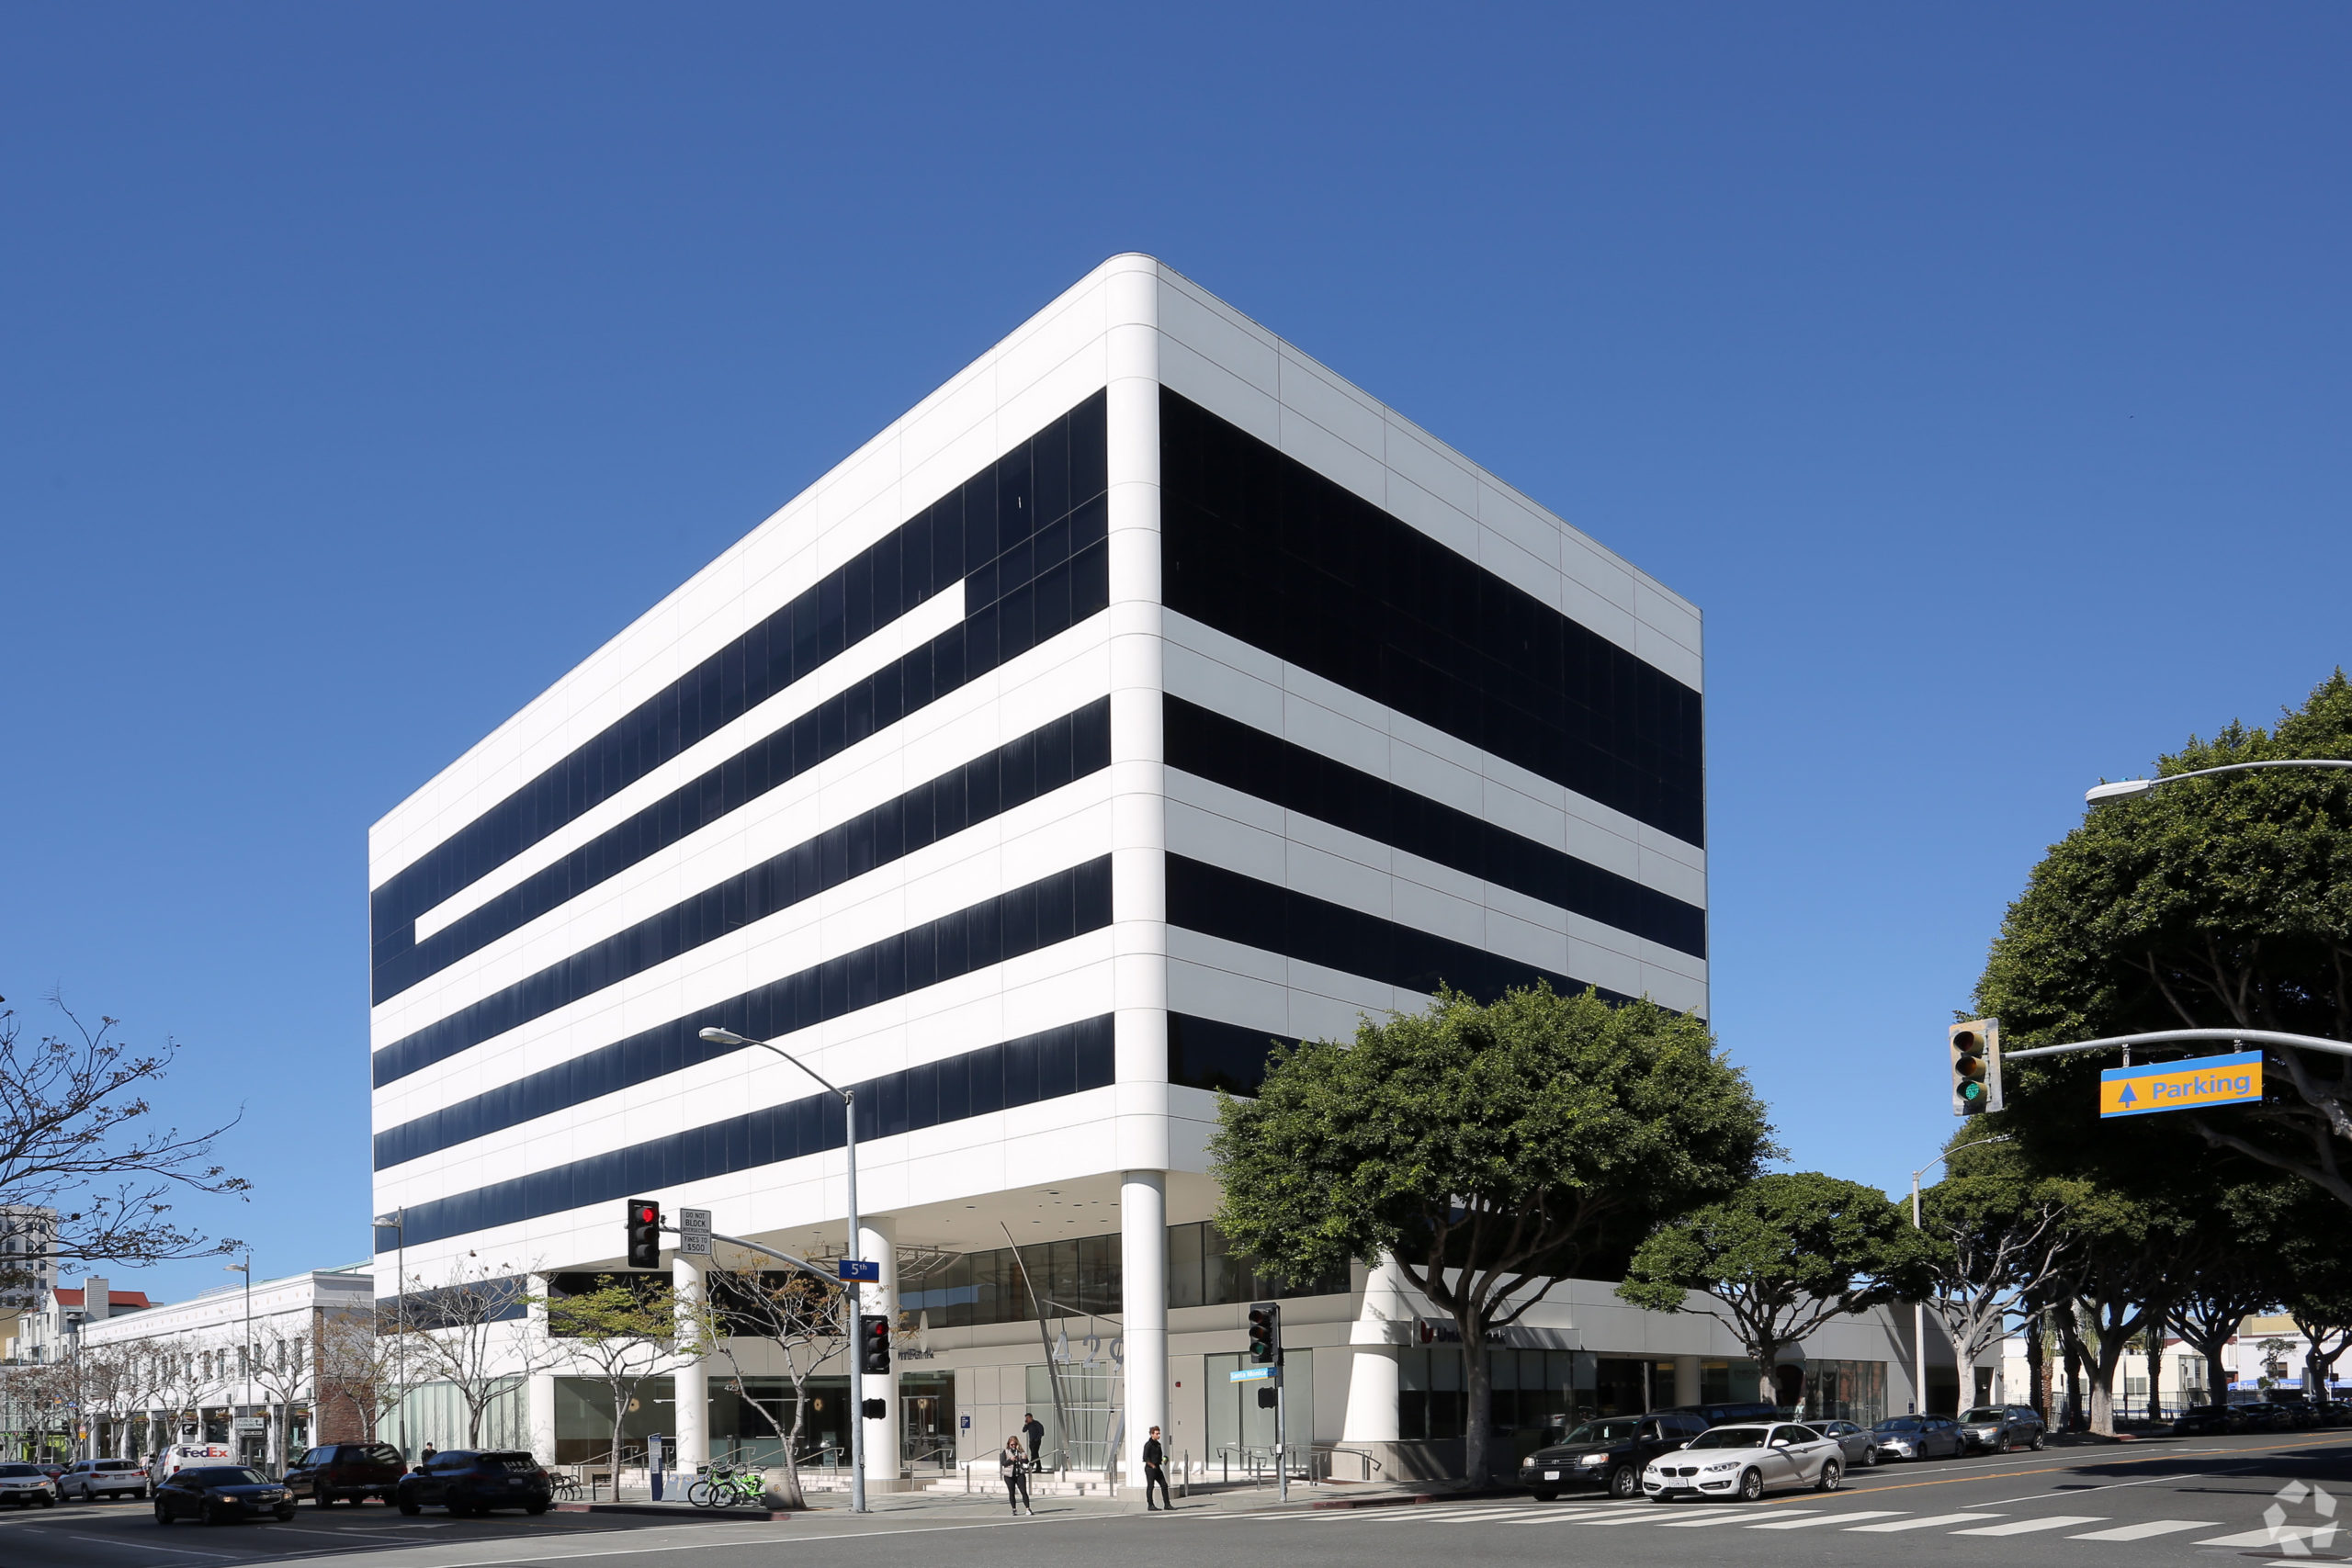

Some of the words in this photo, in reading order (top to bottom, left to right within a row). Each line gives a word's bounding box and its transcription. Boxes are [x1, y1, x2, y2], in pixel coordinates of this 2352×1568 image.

[2153, 1074, 2251, 1100] Parking
[685, 1219, 706, 1227] BLOCK
[687, 1243, 706, 1251] $500
[851, 1263, 867, 1275] 5th
[1052, 1331, 1124, 1371] 429
[183, 1447, 228, 1458] FedEx
